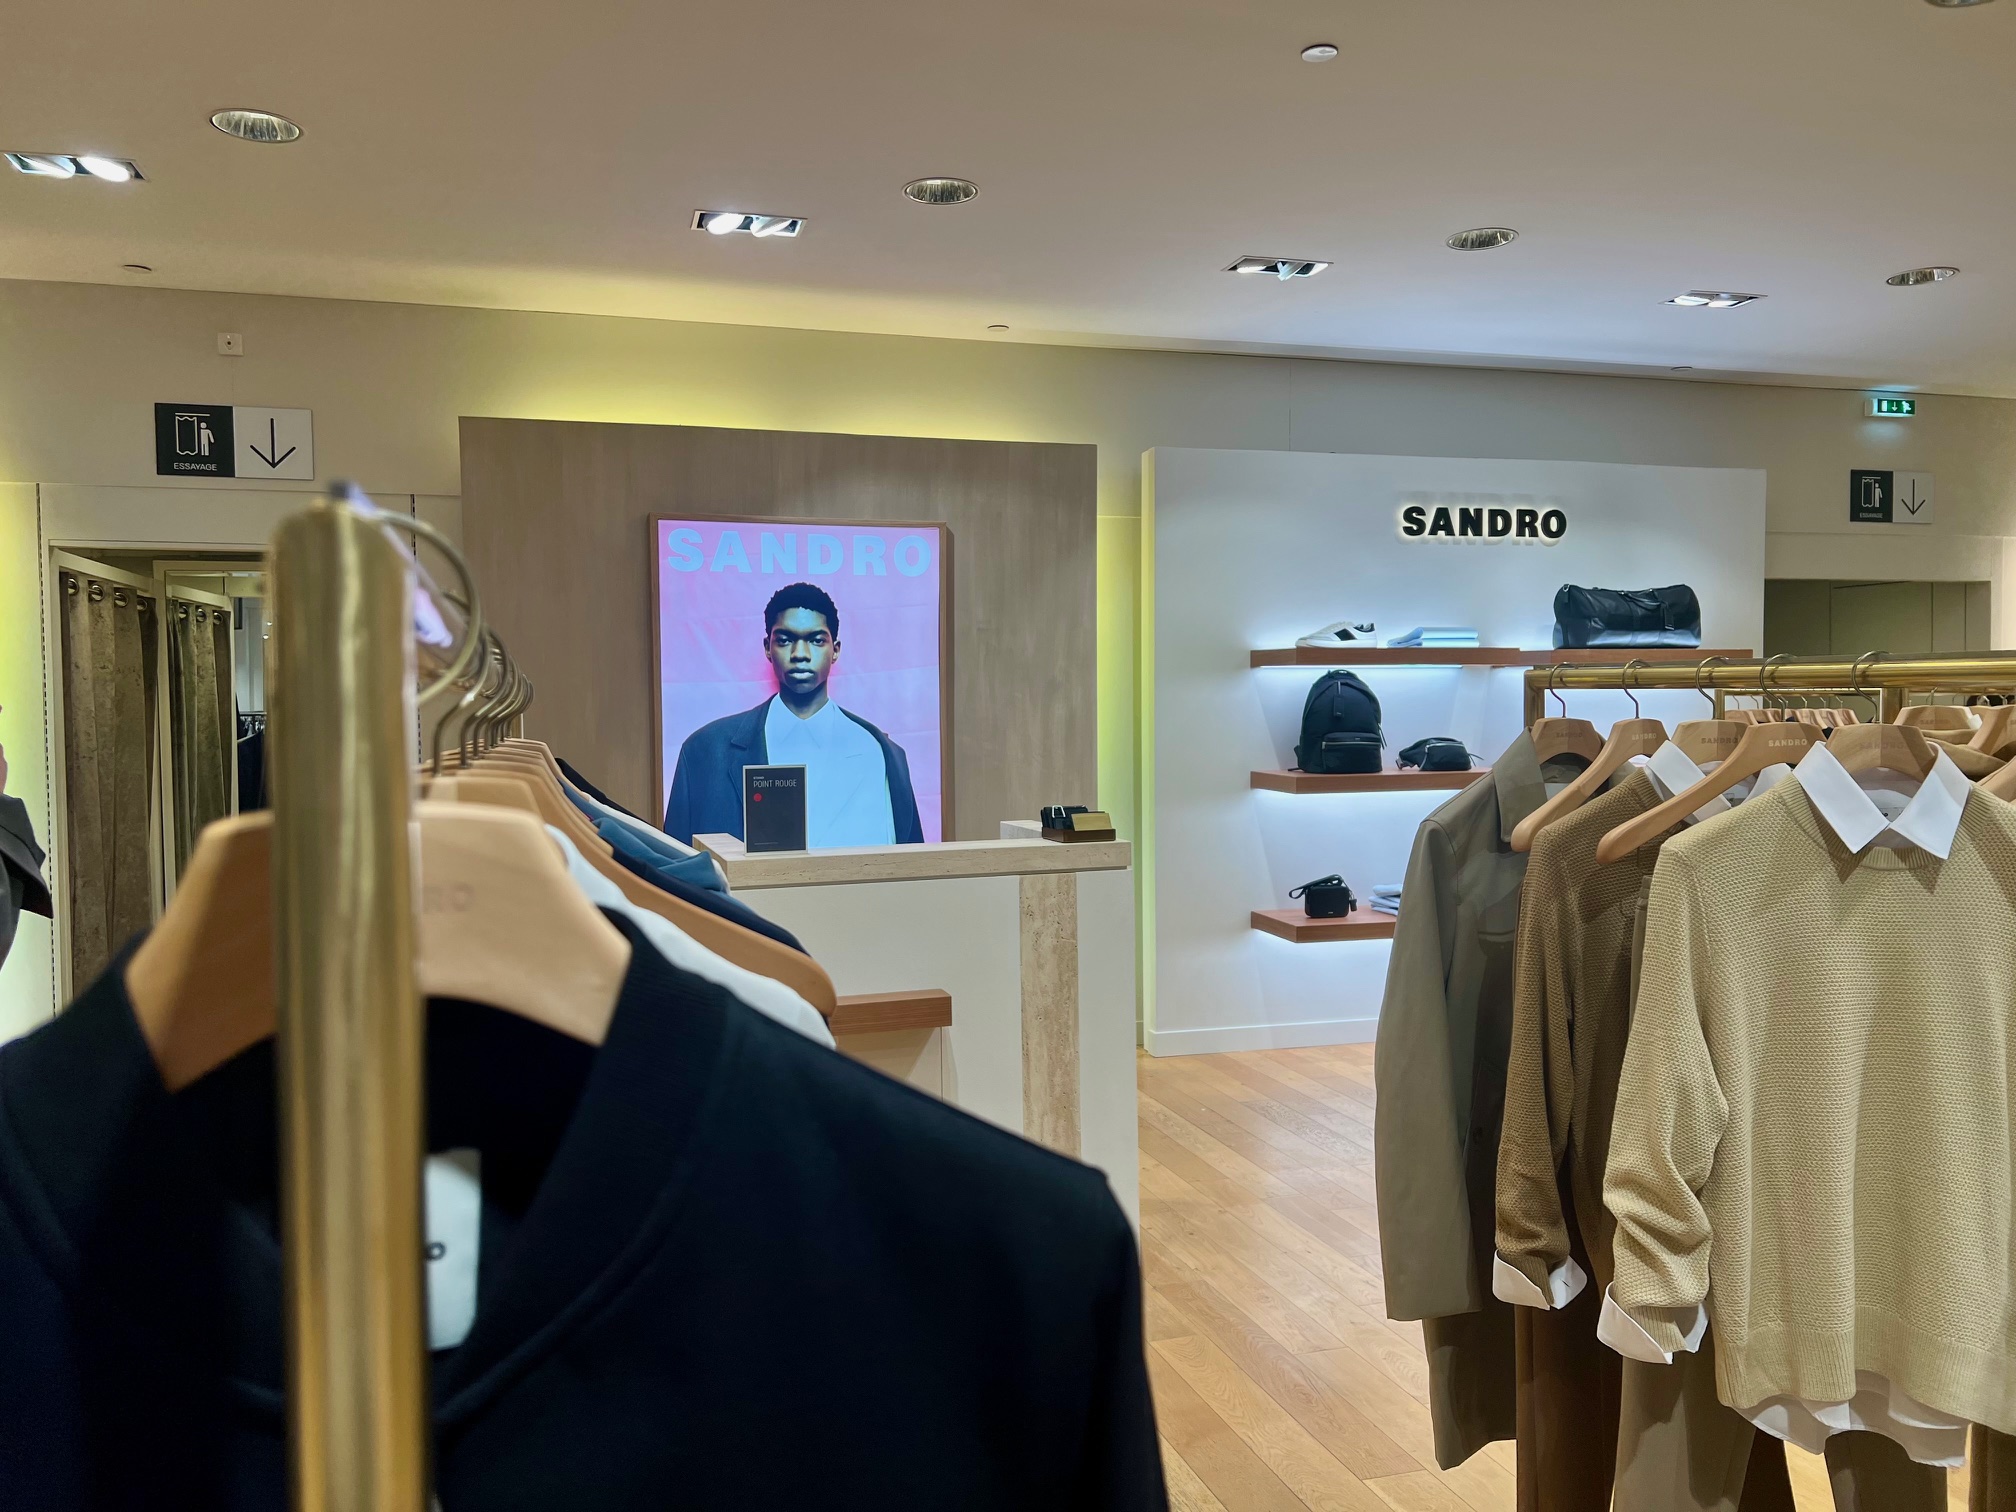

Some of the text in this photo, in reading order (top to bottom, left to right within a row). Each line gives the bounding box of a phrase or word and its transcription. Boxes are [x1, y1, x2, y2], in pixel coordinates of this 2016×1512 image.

[173, 462, 218, 471] ESSAYAGE
[1402, 506, 1567, 539] SANDRO
[668, 528, 932, 577] SANDRO
[1768, 738, 1808, 747] SANDRO
[753, 779, 797, 788] POINT ROUGE
